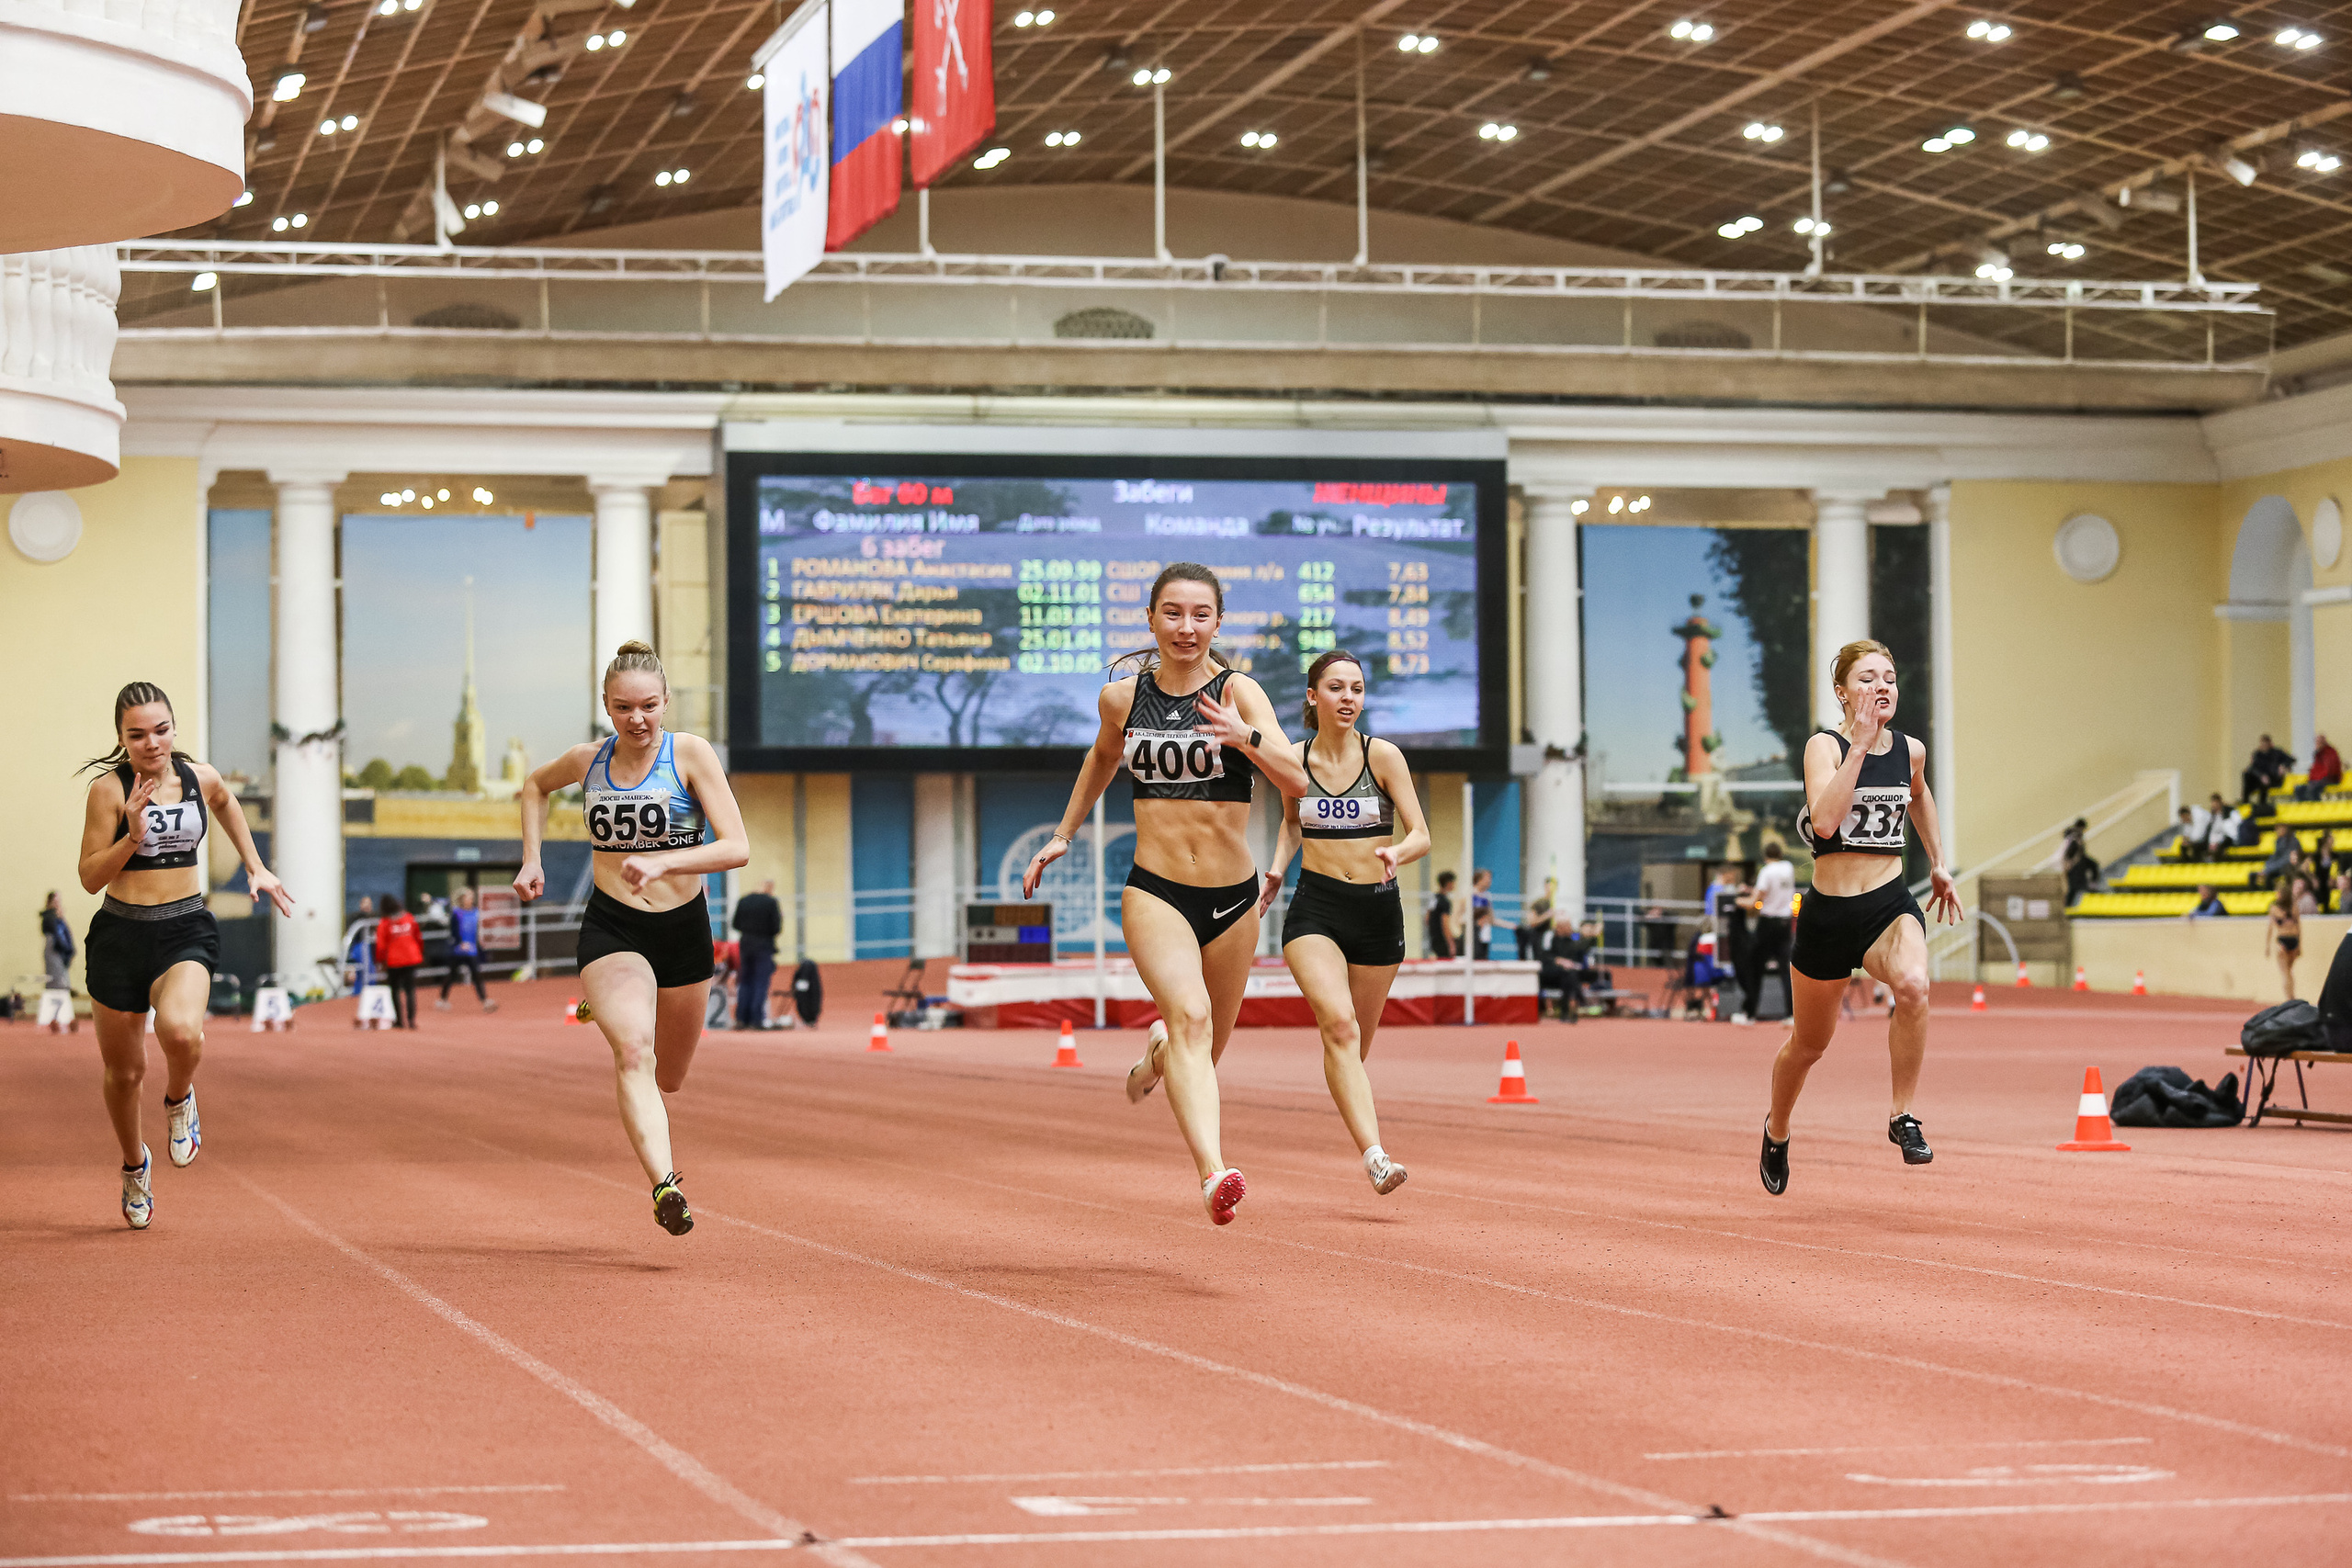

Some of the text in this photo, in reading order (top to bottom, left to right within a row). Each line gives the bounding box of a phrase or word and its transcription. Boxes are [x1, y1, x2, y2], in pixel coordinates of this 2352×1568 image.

[1114, 479, 1193, 503] Забеги
[1312, 482, 1448, 508] ЖЕНЩИНЫ
[812, 509, 979, 534] Фамилия Имя
[1145, 513, 1249, 536] Команда
[1352, 513, 1464, 540] Результат
[882, 536, 946, 558] забег
[768, 557, 778, 578] 1
[791, 558, 910, 578] РОМАНОВА
[1297, 561, 1336, 581] 412
[1387, 561, 1429, 582] 7,63
[766, 580, 780, 601] 2
[1298, 582, 1335, 604] 654
[766, 604, 780, 625] 3
[1298, 606, 1336, 627] 217
[765, 627, 781, 647] 4
[765, 650, 781, 672] 5
[1132, 739, 1214, 780] 400
[1317, 799, 1360, 819] 989
[1862, 795, 1903, 803] СДЮСШОР
[148, 808, 184, 833] 37
[589, 804, 666, 842] 659
[668, 834, 694, 845] ONE
[1374, 881, 1394, 894] NIKE
[707, 987, 727, 1029] 2
